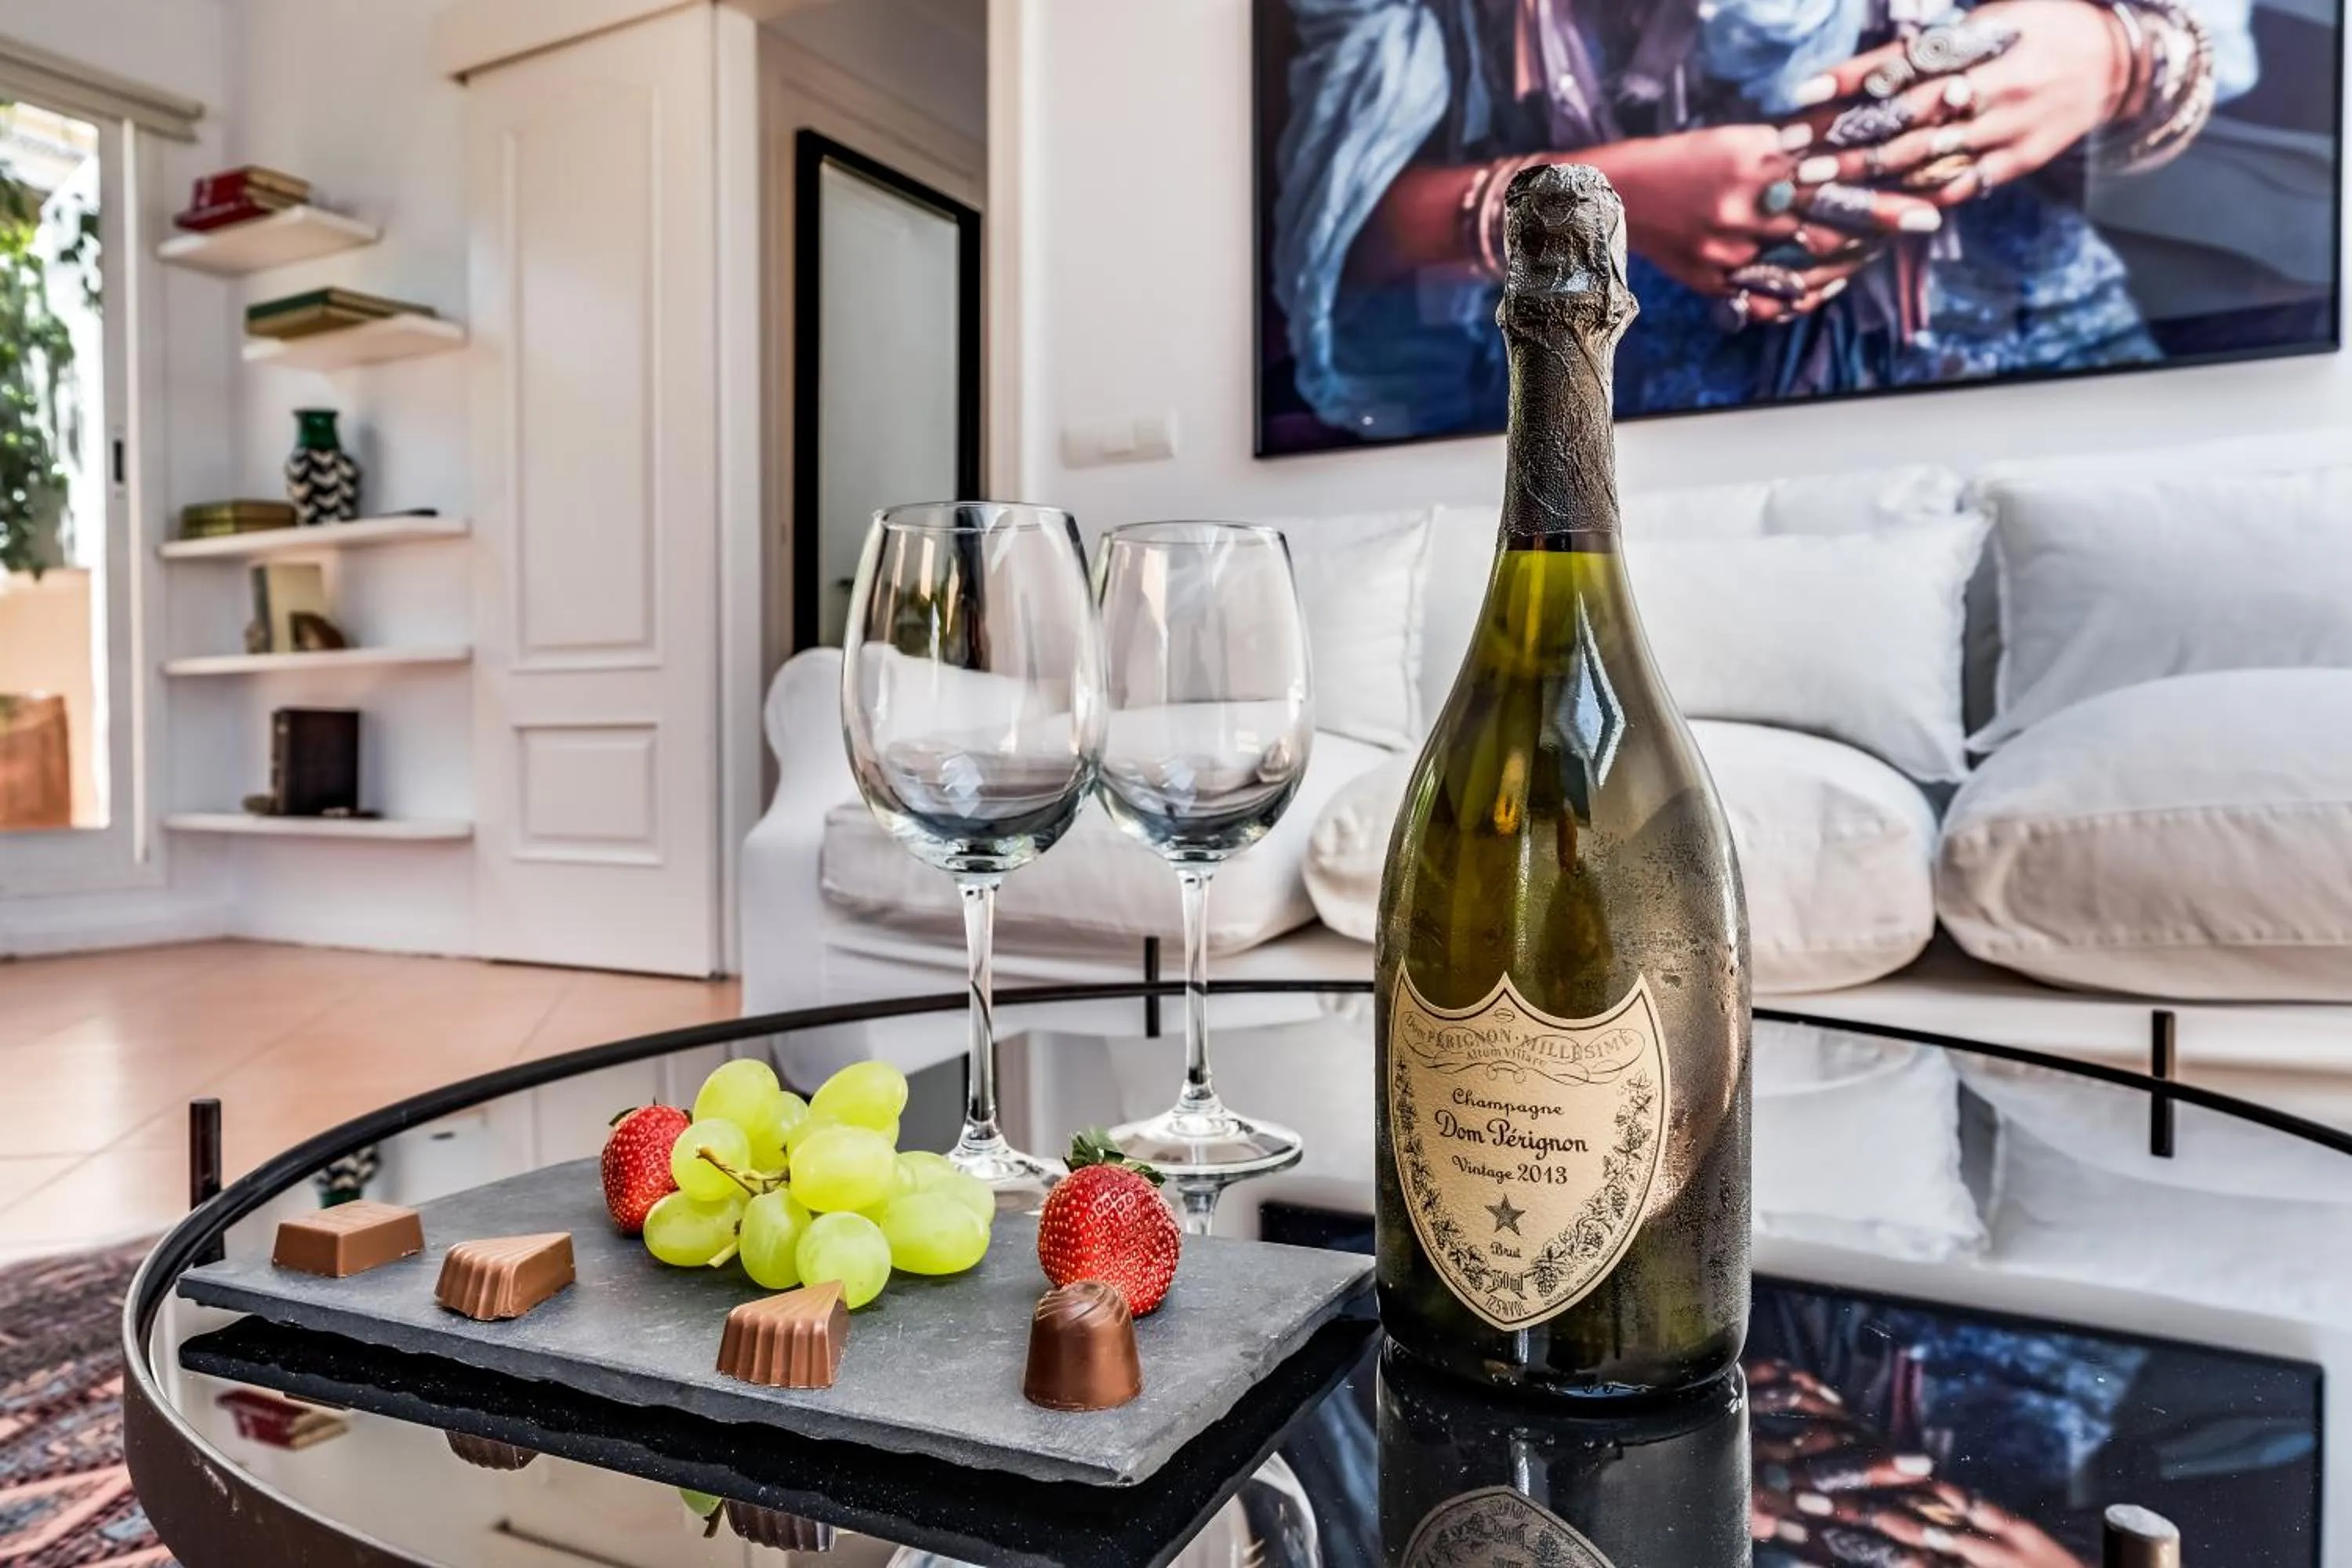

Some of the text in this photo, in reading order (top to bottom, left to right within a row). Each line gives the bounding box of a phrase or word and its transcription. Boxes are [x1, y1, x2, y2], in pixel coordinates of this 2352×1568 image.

[1451, 1087, 1565, 1120] Champagne
[1434, 1109, 1588, 1161] Dom Pérignon
[1452, 1155, 1568, 1185] Vintage 2013
[1490, 1241, 1522, 1258] Brut
